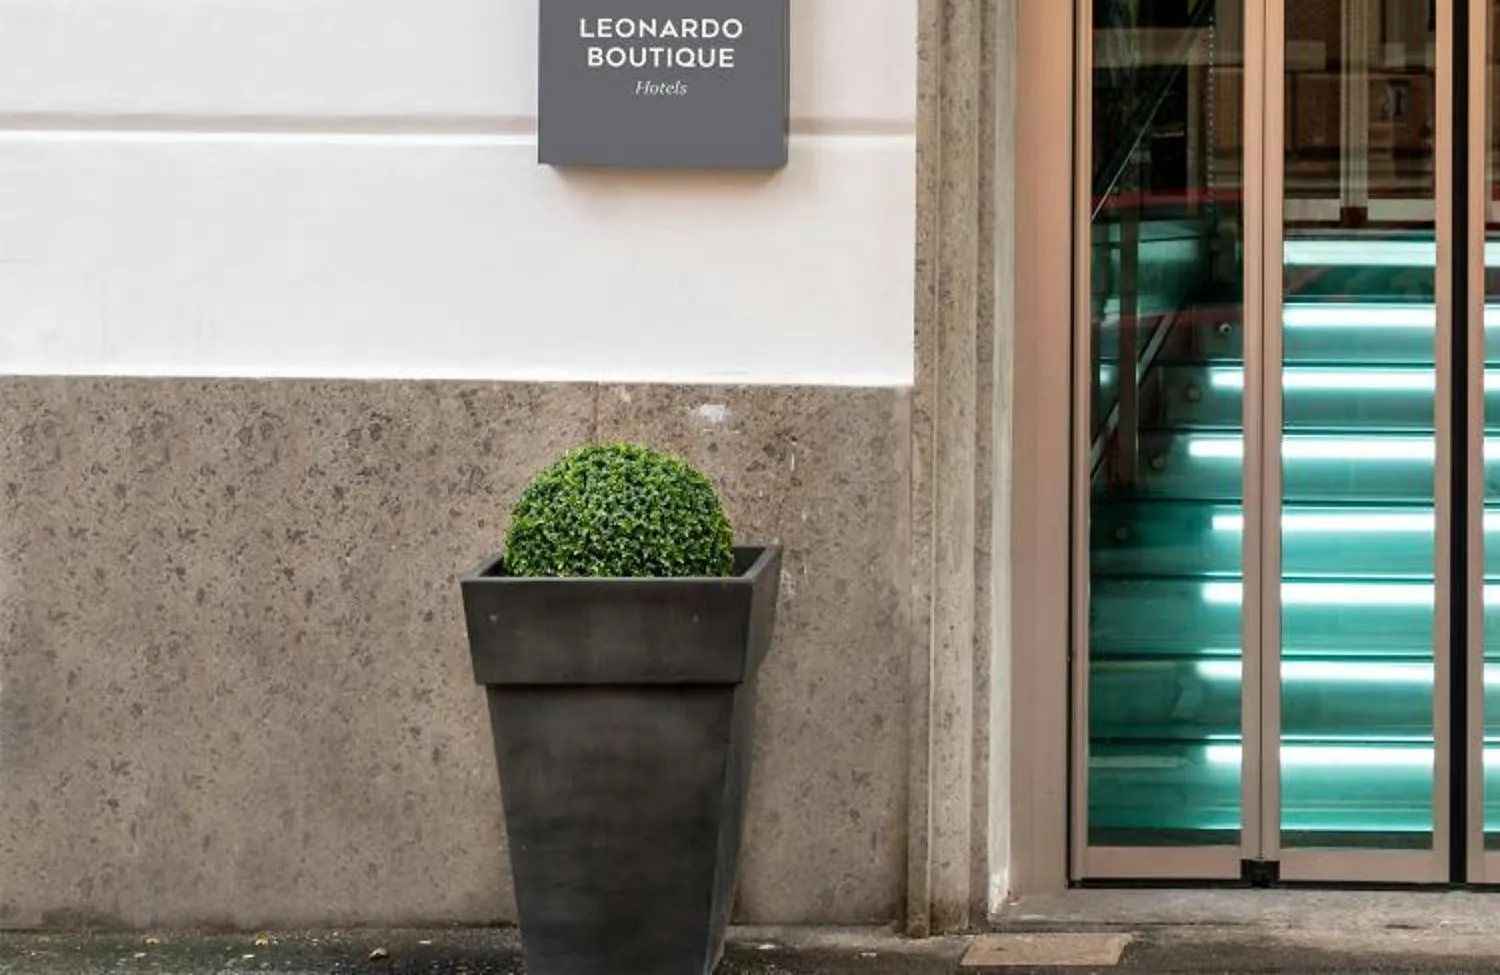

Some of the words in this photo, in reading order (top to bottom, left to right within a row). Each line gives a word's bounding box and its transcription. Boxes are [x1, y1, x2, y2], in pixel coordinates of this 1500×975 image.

[579, 17, 743, 39] LEONARDO
[587, 46, 735, 68] BOUTIQUE
[635, 80, 688, 96] Hotels
